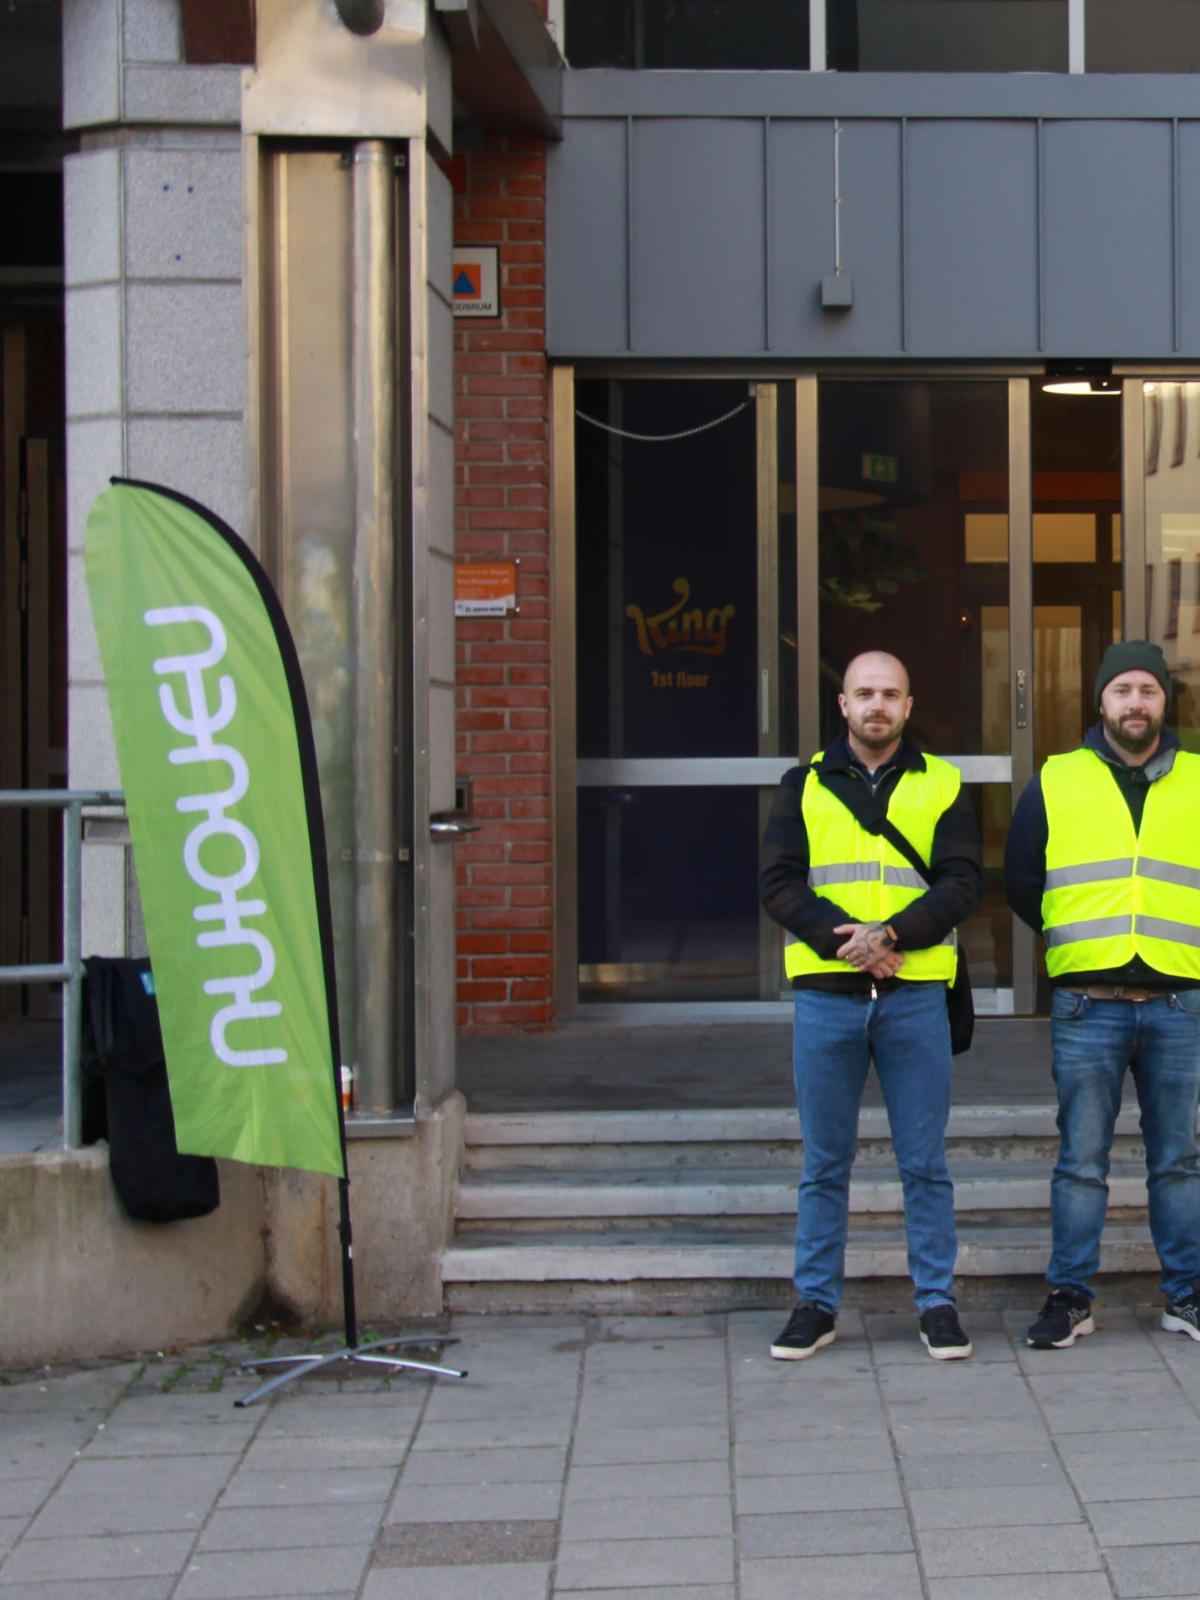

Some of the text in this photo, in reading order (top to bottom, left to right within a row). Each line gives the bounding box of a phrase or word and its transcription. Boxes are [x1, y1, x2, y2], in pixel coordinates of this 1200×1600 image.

[625, 577, 735, 656] King
[651, 670, 709, 687] 1st floor
